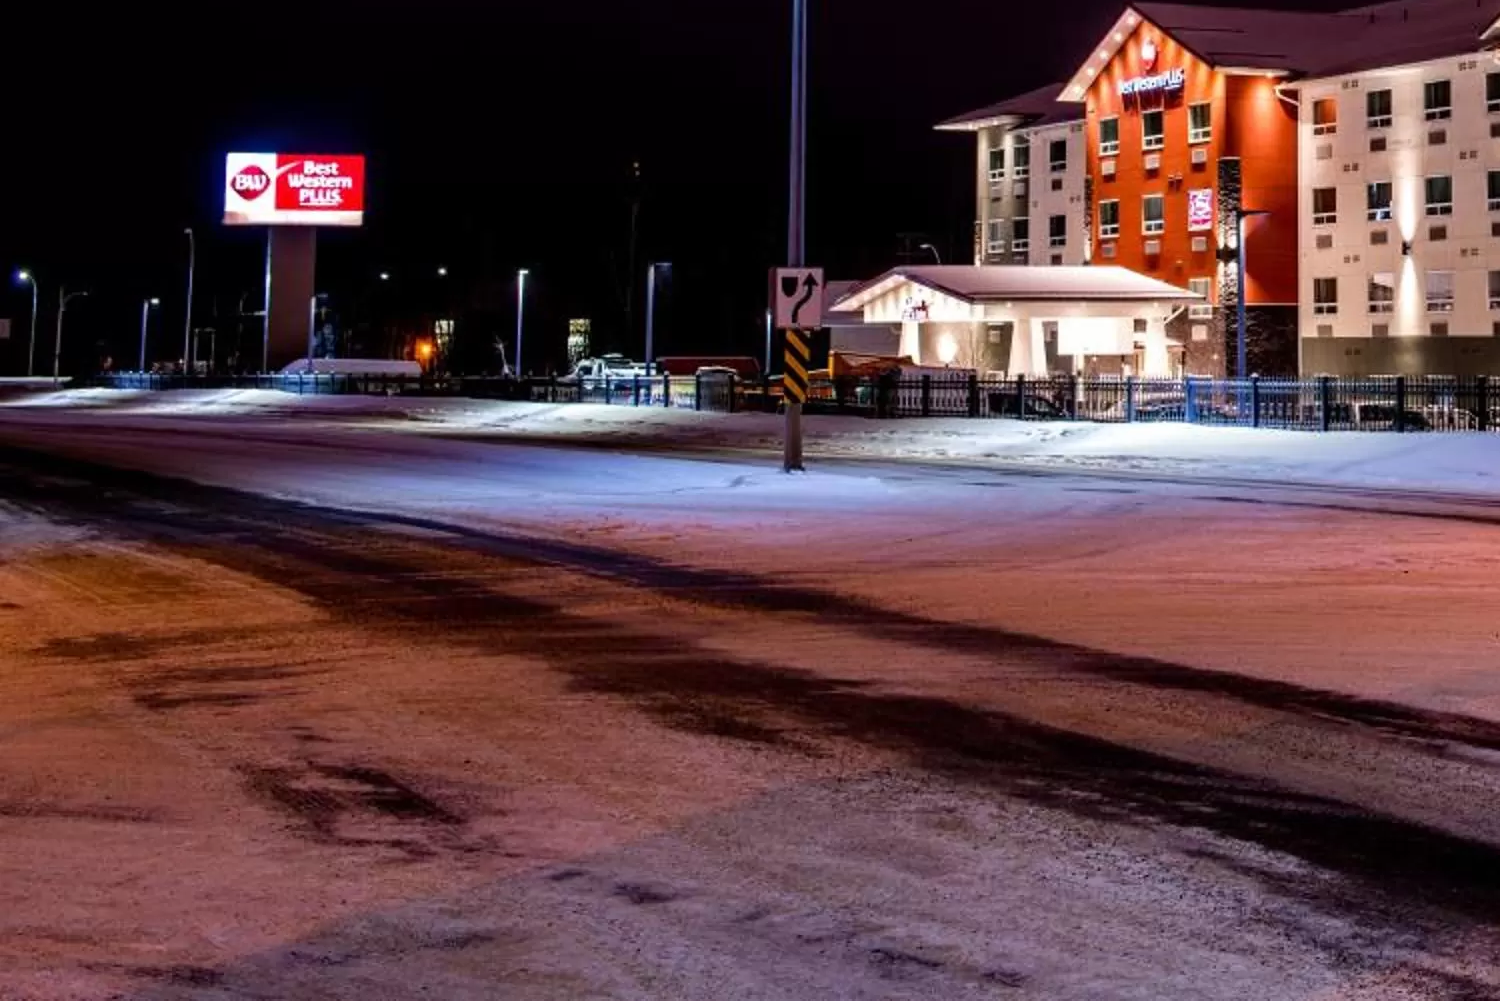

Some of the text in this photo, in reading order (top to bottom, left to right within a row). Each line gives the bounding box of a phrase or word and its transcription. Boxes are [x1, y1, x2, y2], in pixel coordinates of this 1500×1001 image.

[303, 160, 339, 175] Best
[235, 173, 266, 191] BW
[288, 174, 353, 189] Western
[299, 189, 341, 203] PLUS
